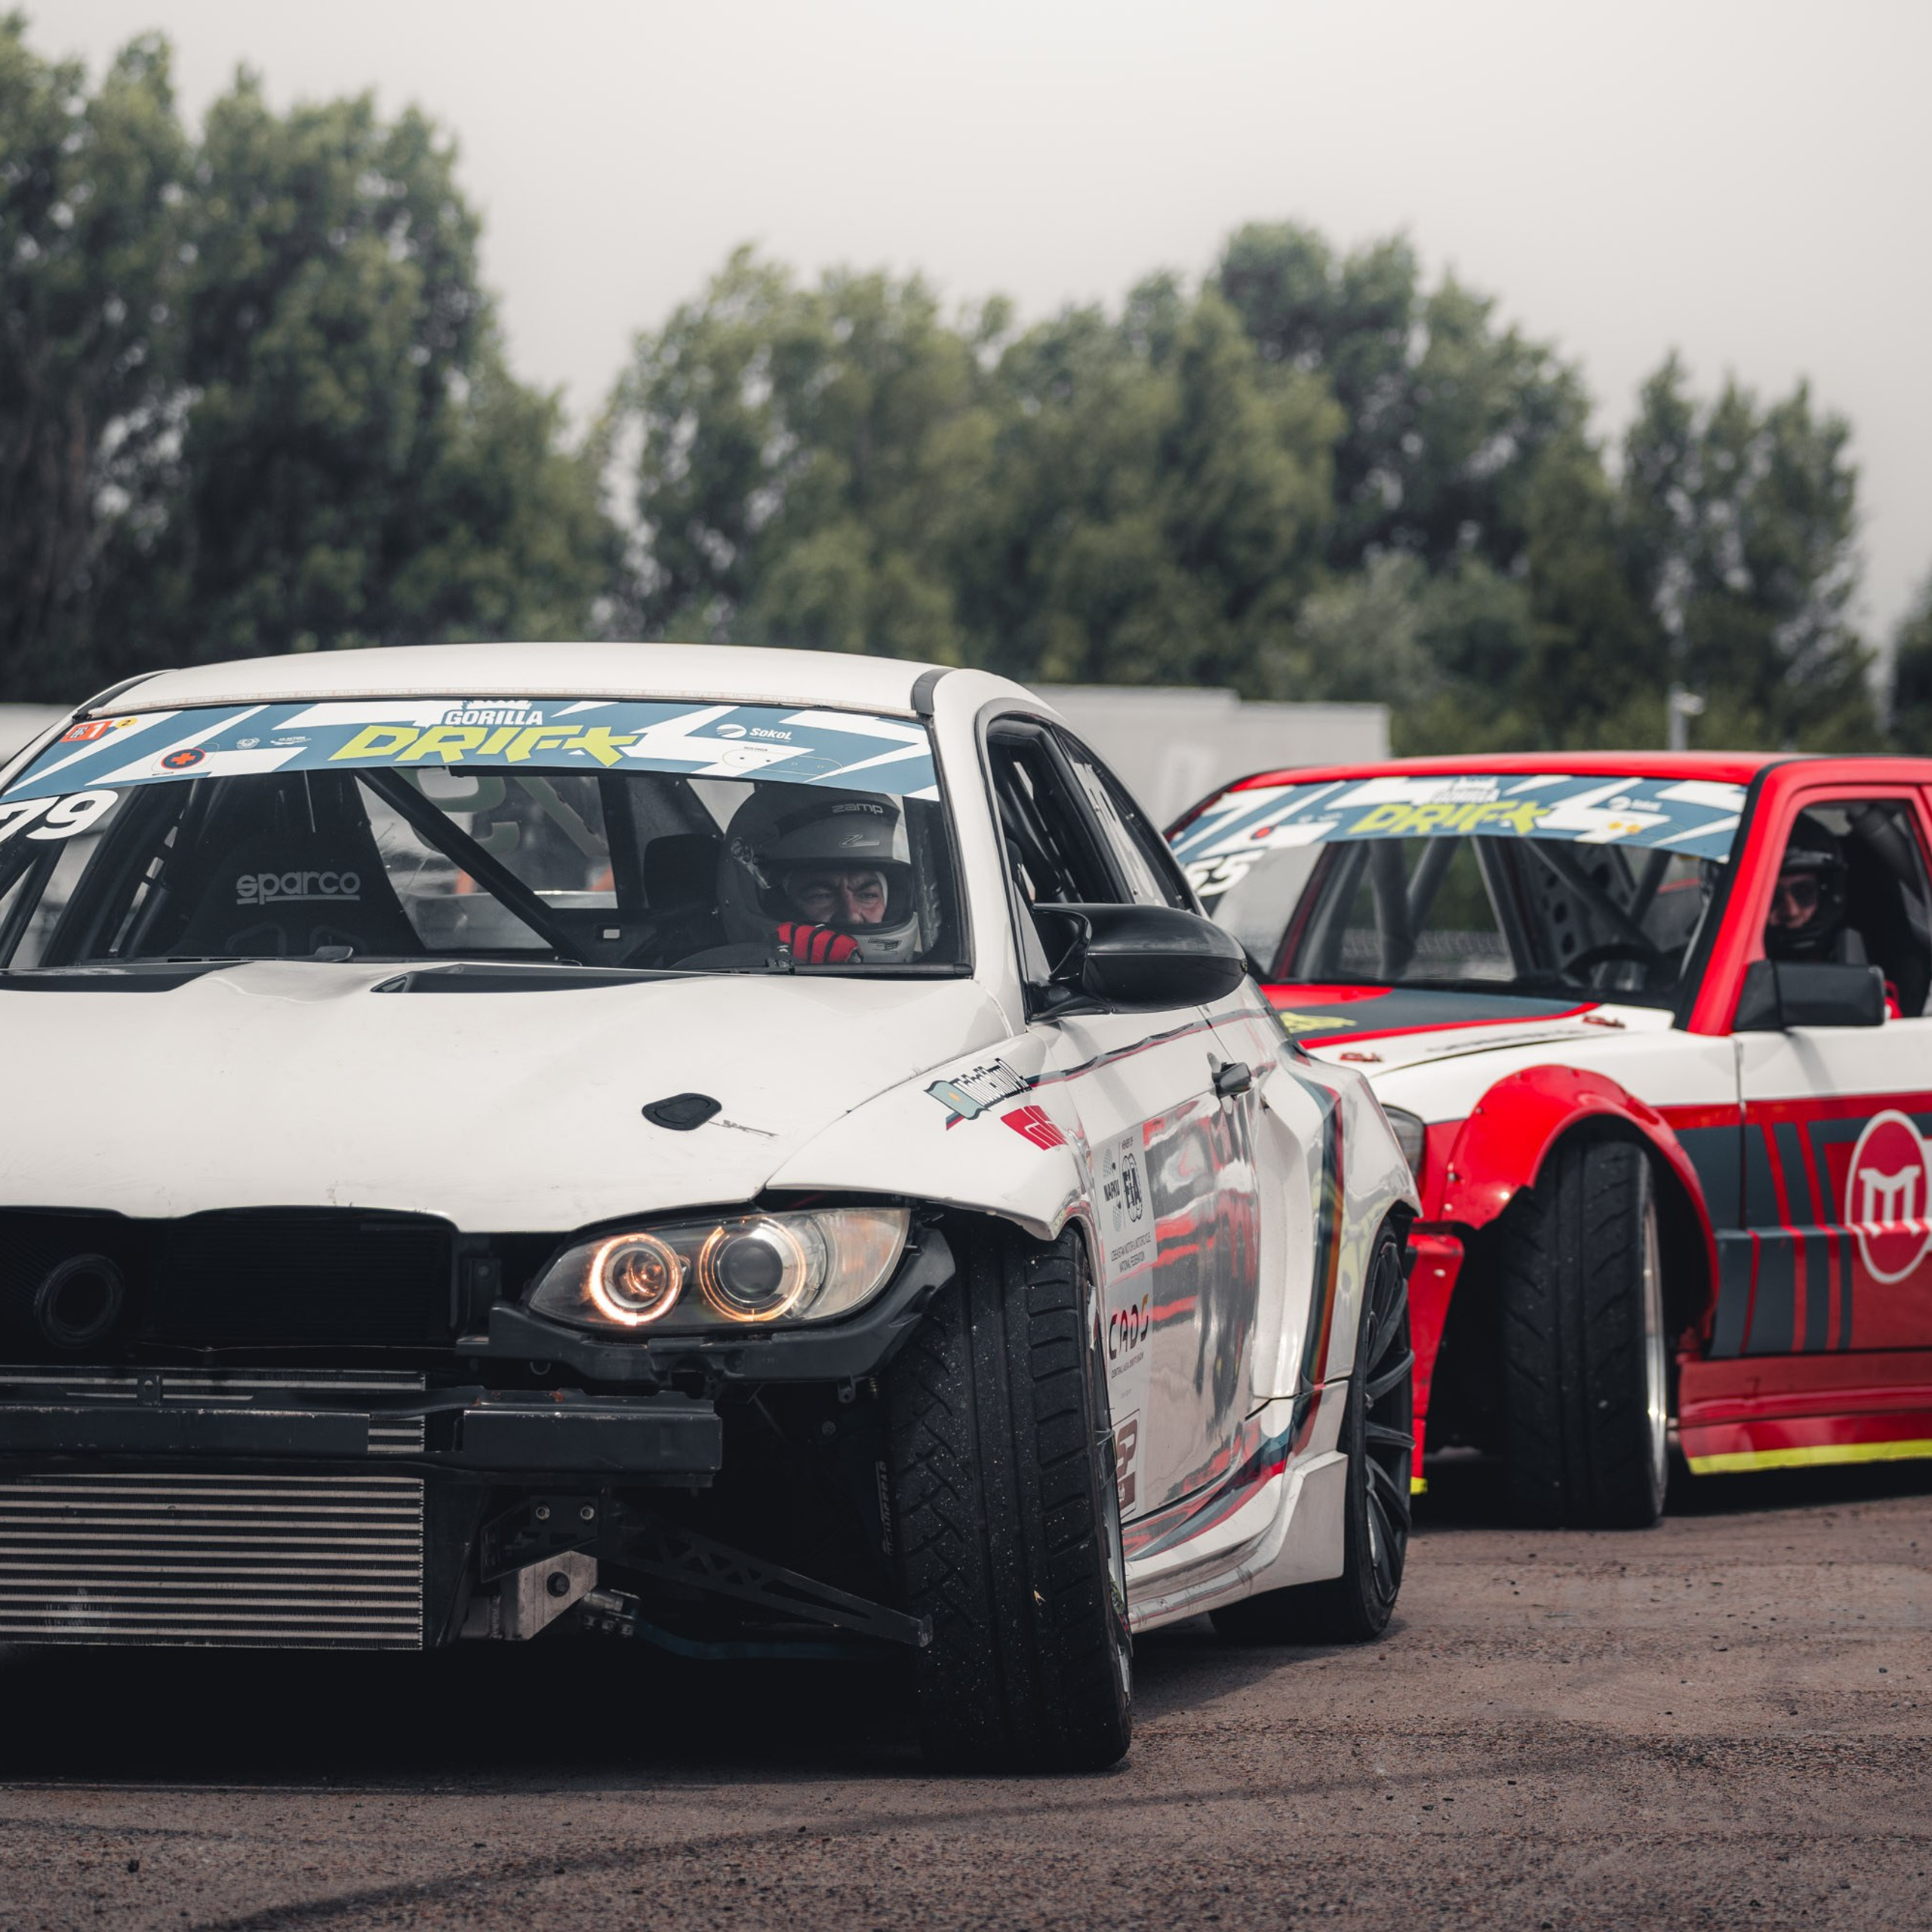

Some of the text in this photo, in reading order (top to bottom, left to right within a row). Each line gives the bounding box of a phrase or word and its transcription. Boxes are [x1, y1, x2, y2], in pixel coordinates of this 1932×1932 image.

[88, 722, 106, 738] 1
[445, 711, 543, 725] GORILLA
[329, 724, 638, 768] DRIFT
[0, 789, 118, 843] 79
[831, 803, 884, 814] zamp
[1347, 800, 1552, 836] DRIFT
[236, 870, 361, 905] sparco
[1122, 1168, 1142, 1209] FIA
[1109, 1294, 1149, 1360] CADS
